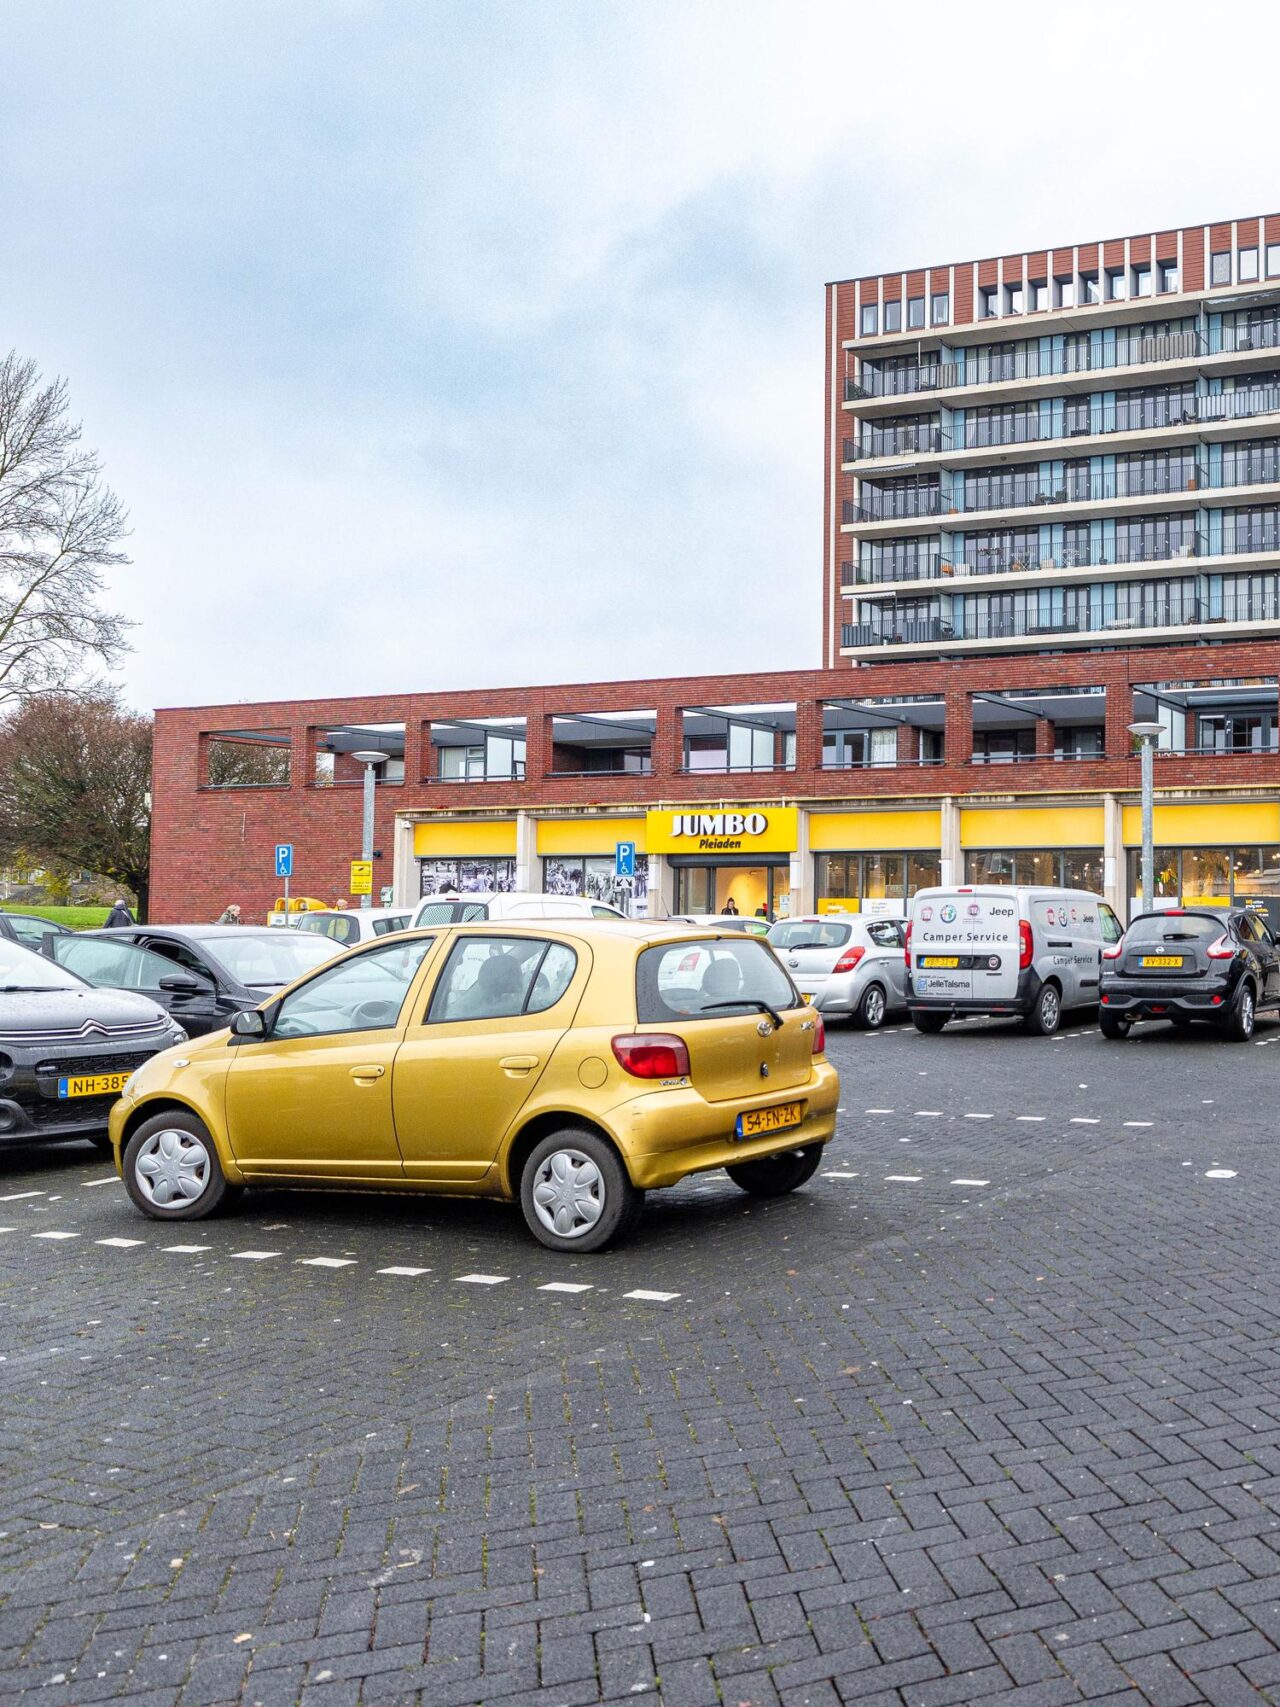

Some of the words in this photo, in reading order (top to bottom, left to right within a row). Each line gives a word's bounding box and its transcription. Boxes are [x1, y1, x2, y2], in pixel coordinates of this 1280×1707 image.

[670, 813, 768, 837] JUMBO
[699, 838, 742, 849] Pleiaden
[279, 847, 288, 863] P
[619, 845, 630, 862] P
[989, 907, 1014, 917] Jeep
[923, 932, 962, 943] Camper
[966, 932, 1009, 942] Service
[1053, 956, 1073, 966] Camper
[1074, 955, 1093, 965] Service
[1144, 957, 1179, 966] XV-332-X
[747, 1106, 797, 1131] 54-FN-ZK
